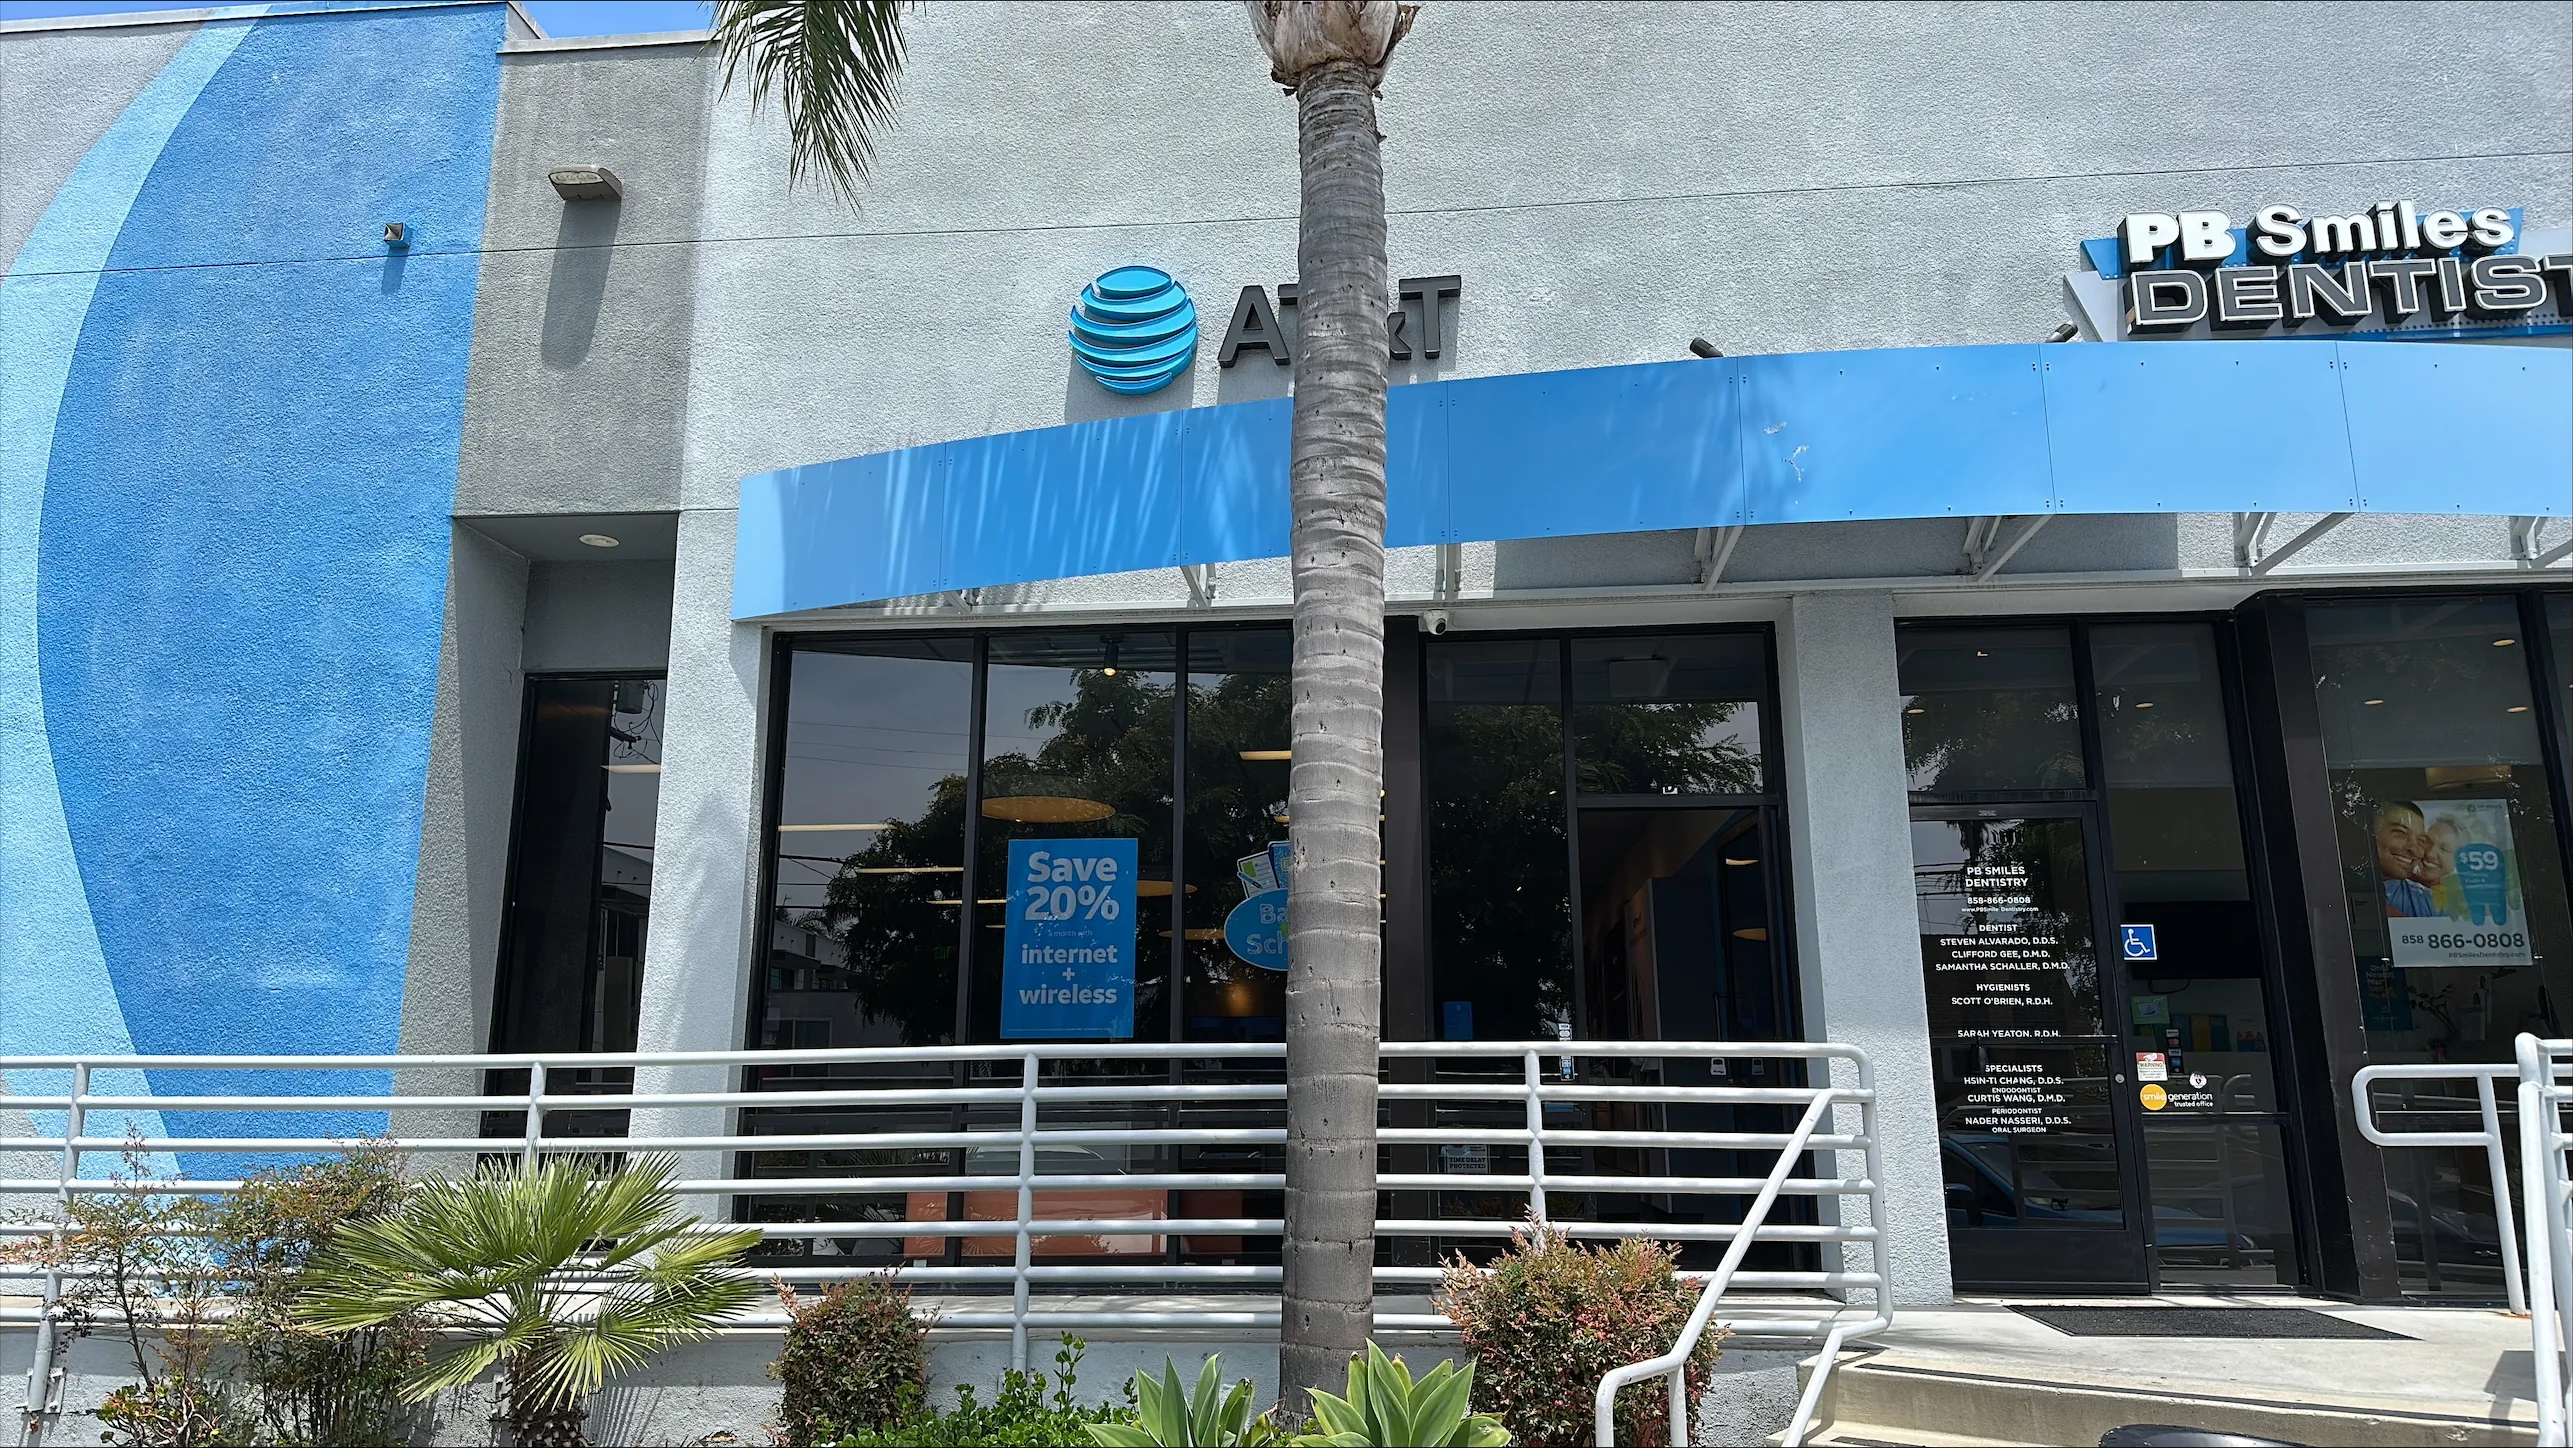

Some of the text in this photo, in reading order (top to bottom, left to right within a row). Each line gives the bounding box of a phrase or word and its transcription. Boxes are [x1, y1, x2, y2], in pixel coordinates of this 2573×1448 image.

[2123, 199, 2515, 263] PB Smiles
[1218, 275, 1461, 366] AT
[2460, 850, 2499, 871] $59
[1027, 851, 1118, 883] Save
[1966, 866, 2026, 876] PB SMILES
[1965, 877, 2028, 887] DENTISTRY
[1025, 884, 1120, 921] 20%
[1967, 896, 2031, 905] 858-866-0808
[1259, 903, 1289, 925] Ba
[1979, 924, 2018, 932] DENTIST
[1246, 930, 1289, 955] Sch
[1940, 937, 2059, 946] STEVEN ALVARADO, D.D.S.
[2401, 933, 2525, 949] 858 866-0808
[1021, 943, 1118, 964] internet
[1951, 950, 2051, 959] CLIFFORD GEE, D.M.D.
[1935, 962, 2071, 971] SAMANTHA SCHALLER, D.M.D.
[1062, 967, 1075, 981] +
[1976, 983, 2031, 992] HYGIENISTS
[1019, 983, 1118, 1005] wireless
[1951, 997, 2053, 1006] SCOTT O'BRIEN, R.D.H.
[1957, 1029, 1990, 1038] SARAH
[2034, 1029, 2062, 1038] R.D.H.
[1985, 1064, 2043, 1073] SPECIALISTS
[1963, 1076, 2064, 1086] HSIN-TI CHANG, D.D.S.
[1967, 1094, 2066, 1103] CURTIS WANG, D.M.D.
[2143, 1091, 2213, 1102] smile generation
[1965, 1116, 2072, 1126] NADER NASSERI, D.D.S.
[2012, 1126, 2047, 1134] SURGEON
